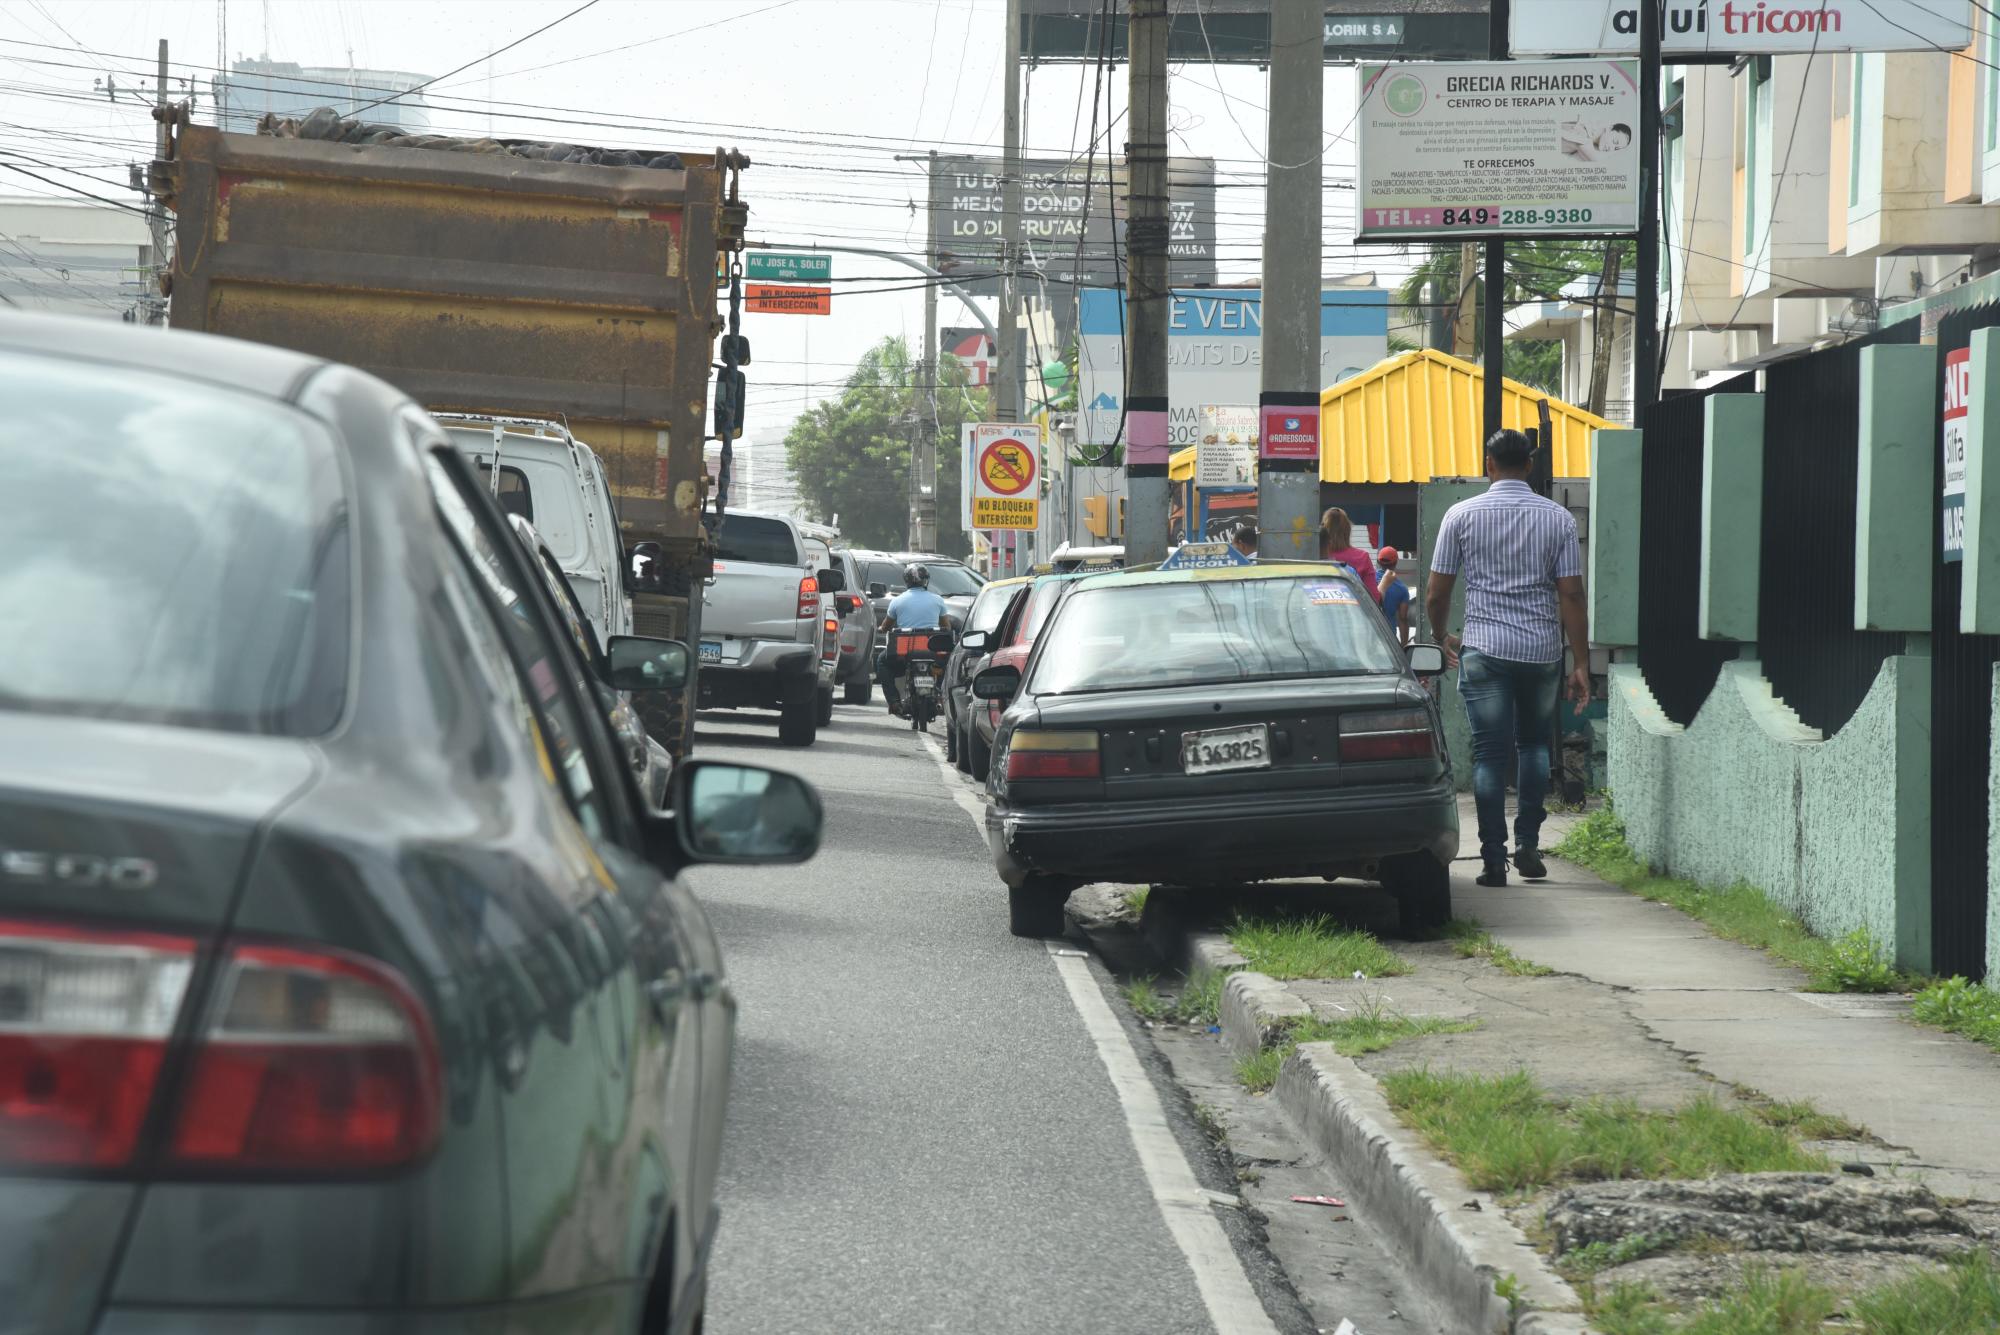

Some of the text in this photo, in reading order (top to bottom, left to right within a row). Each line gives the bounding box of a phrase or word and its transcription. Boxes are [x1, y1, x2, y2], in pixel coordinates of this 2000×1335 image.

[1719, 2, 1842, 34] tricom
[1447, 74, 1614, 92] GRECIA RICHARDS V.
[1447, 96, 1614, 108] CENTRO DE TERAPIA Y MASAJE
[1463, 159, 1535, 168] TE OFRECEMOS
[953, 173, 977, 188] TU
[953, 196, 1003, 211] MEJO
[1375, 210, 1431, 226] TEL.:
[953, 220, 979, 236] LO
[750, 258, 827, 270] AV. JOSE A. SOLER
[760, 290, 772, 298] NO
[759, 300, 818, 310] INTERSECCION
[978, 500, 1034, 512] NO BLOQUEAR
[977, 514, 1033, 526] INTERSECCION
[1170, 560, 1238, 569] LINCOLN
